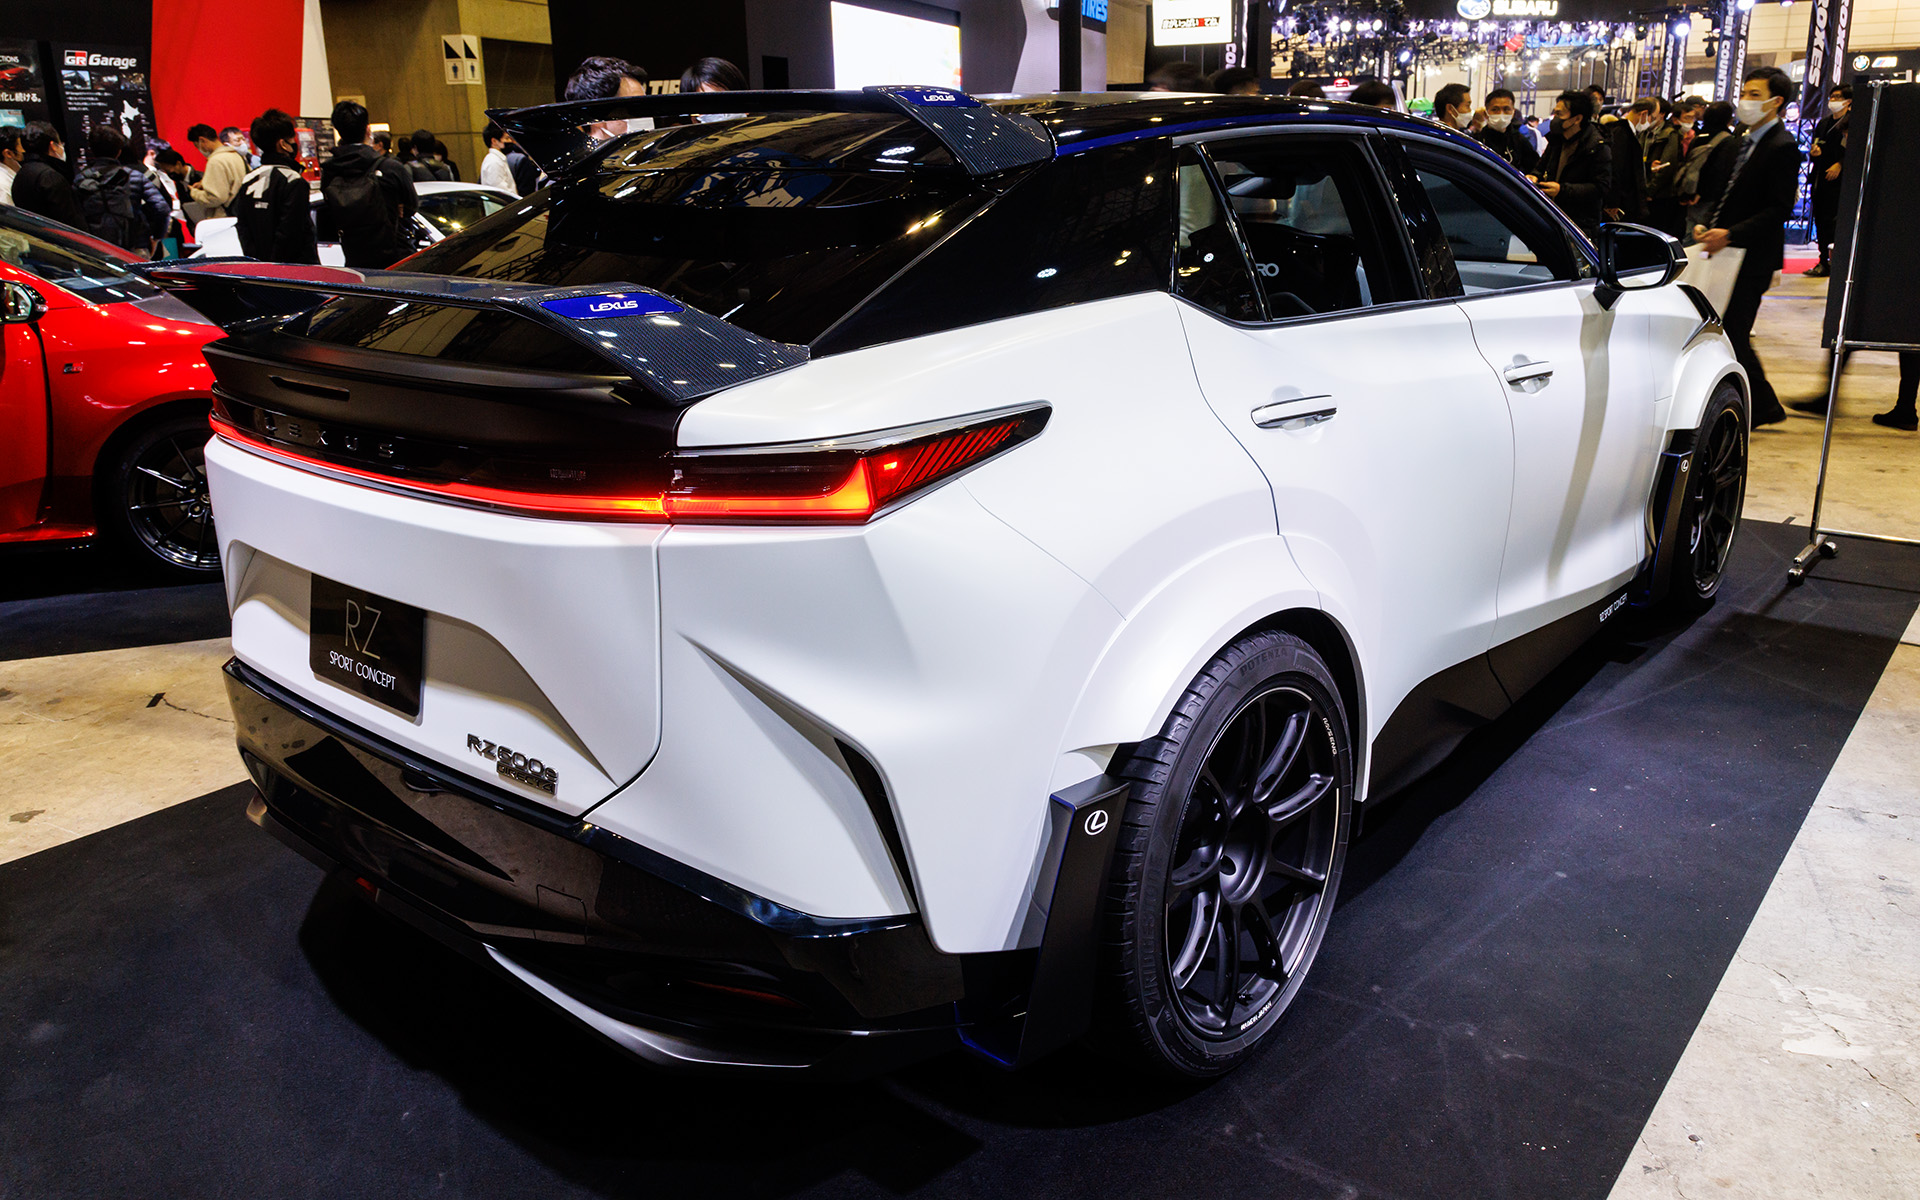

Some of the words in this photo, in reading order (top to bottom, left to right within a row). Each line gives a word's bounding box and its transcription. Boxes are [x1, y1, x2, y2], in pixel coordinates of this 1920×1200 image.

[1492, 0, 1558, 16] SUBARU
[88, 54, 137, 69] Garage
[1716, 40, 1731, 101] COUNTR
[649, 79, 681, 95] TIR
[922, 94, 956, 102] LEXUS
[589, 300, 638, 312] LEXUS
[264, 416, 394, 458] LEXUS
[345, 598, 381, 660] RZ
[329, 650, 353, 672] SPORT
[355, 661, 396, 690] CONCEPT
[1239, 646, 1288, 677] POTENZA
